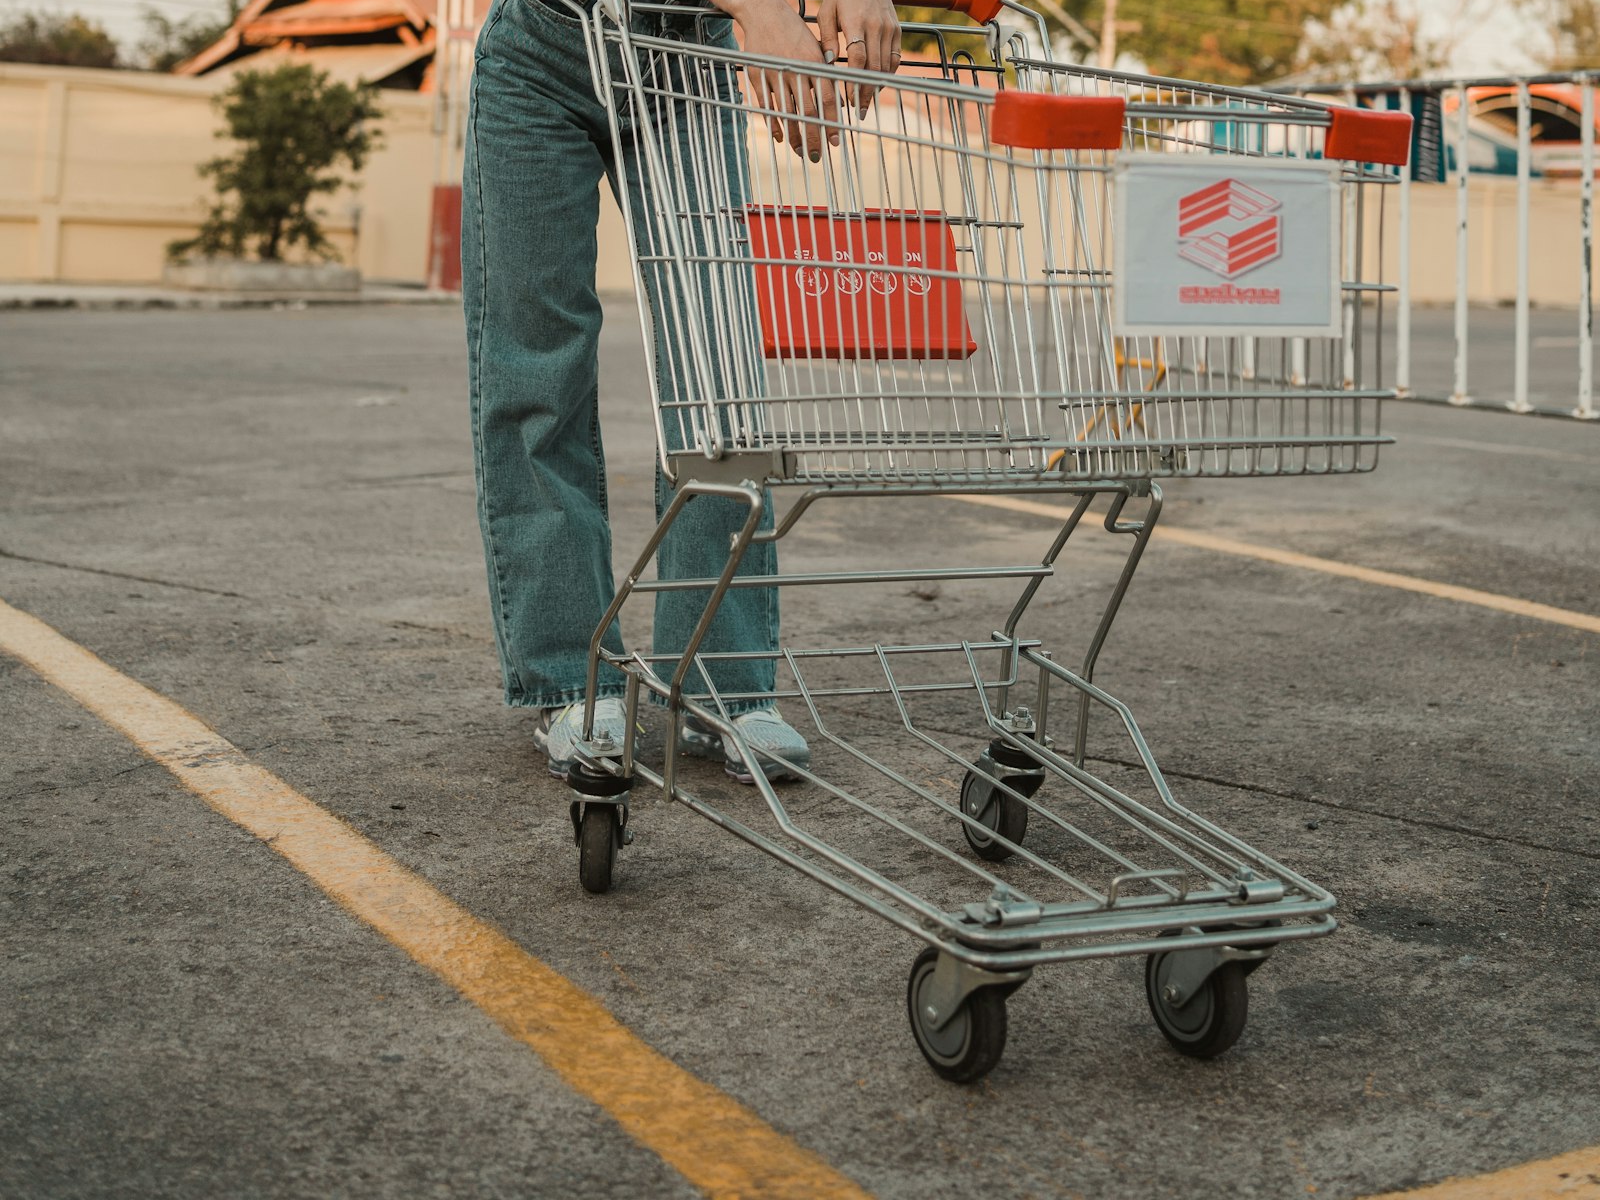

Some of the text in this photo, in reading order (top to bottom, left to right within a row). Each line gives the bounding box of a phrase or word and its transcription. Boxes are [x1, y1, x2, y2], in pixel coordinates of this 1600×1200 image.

[835, 250, 852, 261] NO
[868, 251, 887, 262] NO
[904, 252, 922, 262] NO
